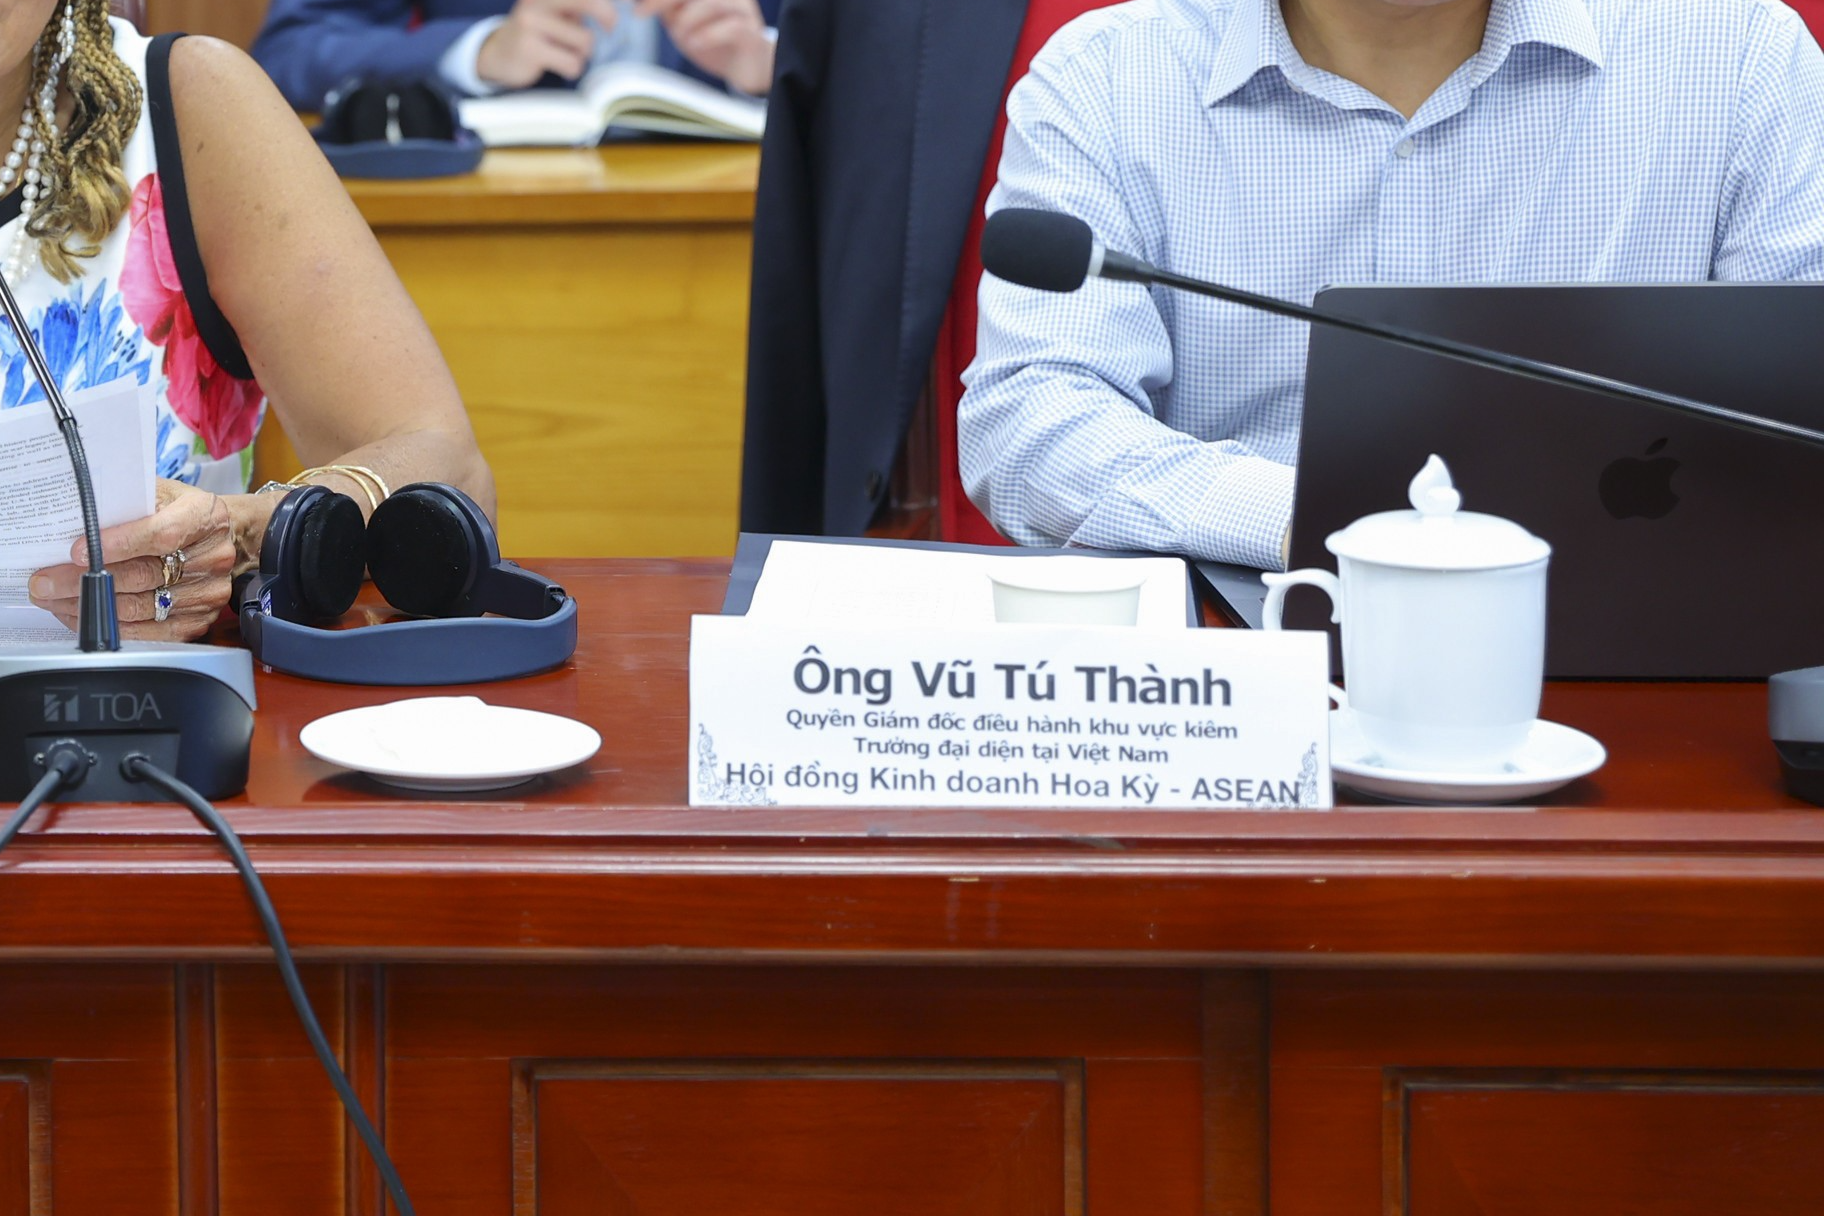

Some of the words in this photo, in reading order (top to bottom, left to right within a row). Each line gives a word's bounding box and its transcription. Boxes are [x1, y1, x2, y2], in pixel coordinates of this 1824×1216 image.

[794, 645, 892, 706] Ông
[911, 660, 975, 699] Vũ
[994, 660, 1055, 701] Tú
[1074, 664, 1231, 706] Thành
[91, 692, 162, 723] TOA
[786, 709, 855, 730] Quyền
[864, 711, 919, 728] Giám
[928, 712, 965, 730] đốc
[973, 714, 1018, 732] điều
[1028, 716, 1080, 733] hành
[1090, 718, 1129, 735] khu
[1138, 722, 1176, 740] vực
[1185, 720, 1237, 738] kiêm
[854, 737, 929, 759] Trưởng
[938, 740, 969, 760] đại
[978, 740, 1023, 761] diện
[1032, 743, 1058, 763] tại
[1068, 743, 1109, 764] Việt
[1119, 746, 1168, 762] Nam
[784, 761, 858, 794] đồng
[871, 767, 935, 791] Kinh
[947, 770, 1038, 794] doanh
[1051, 773, 1109, 797] Hoa
[1122, 774, 1159, 804] Kỳ
[1191, 776, 1301, 804] ASEAN
